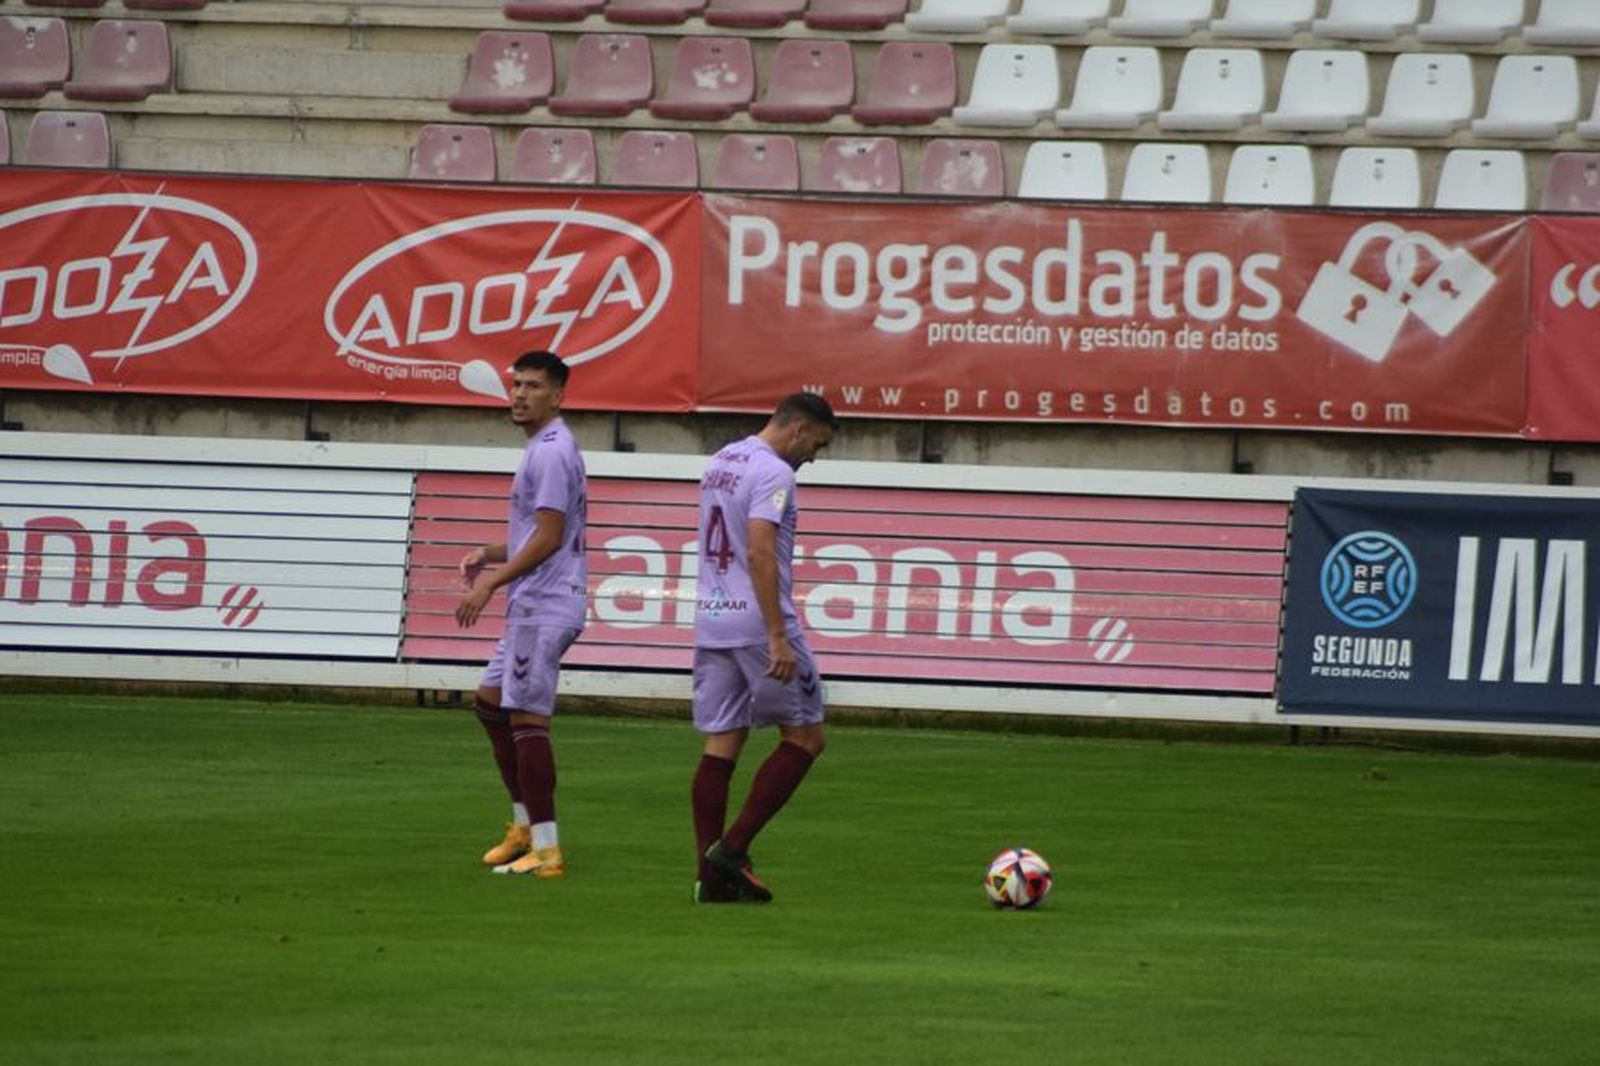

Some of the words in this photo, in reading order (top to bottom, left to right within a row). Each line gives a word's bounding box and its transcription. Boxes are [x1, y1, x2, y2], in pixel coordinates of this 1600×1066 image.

[337, 252, 644, 356] ADOZA
[728, 214, 1283, 333] Progesdatos
[928, 318, 1050, 347] protección
[1059, 324, 1072, 350] y
[1080, 322, 1166, 352] gestión
[1174, 322, 1204, 350] de
[1211, 325, 1279, 351] datos
[0, 515, 207, 612] nia
[704, 505, 733, 575] 4
[1312, 635, 1412, 667] SEGUNDA
[1448, 536, 1600, 684] IM
[1311, 665, 1411, 680] FEDERACIÓN
